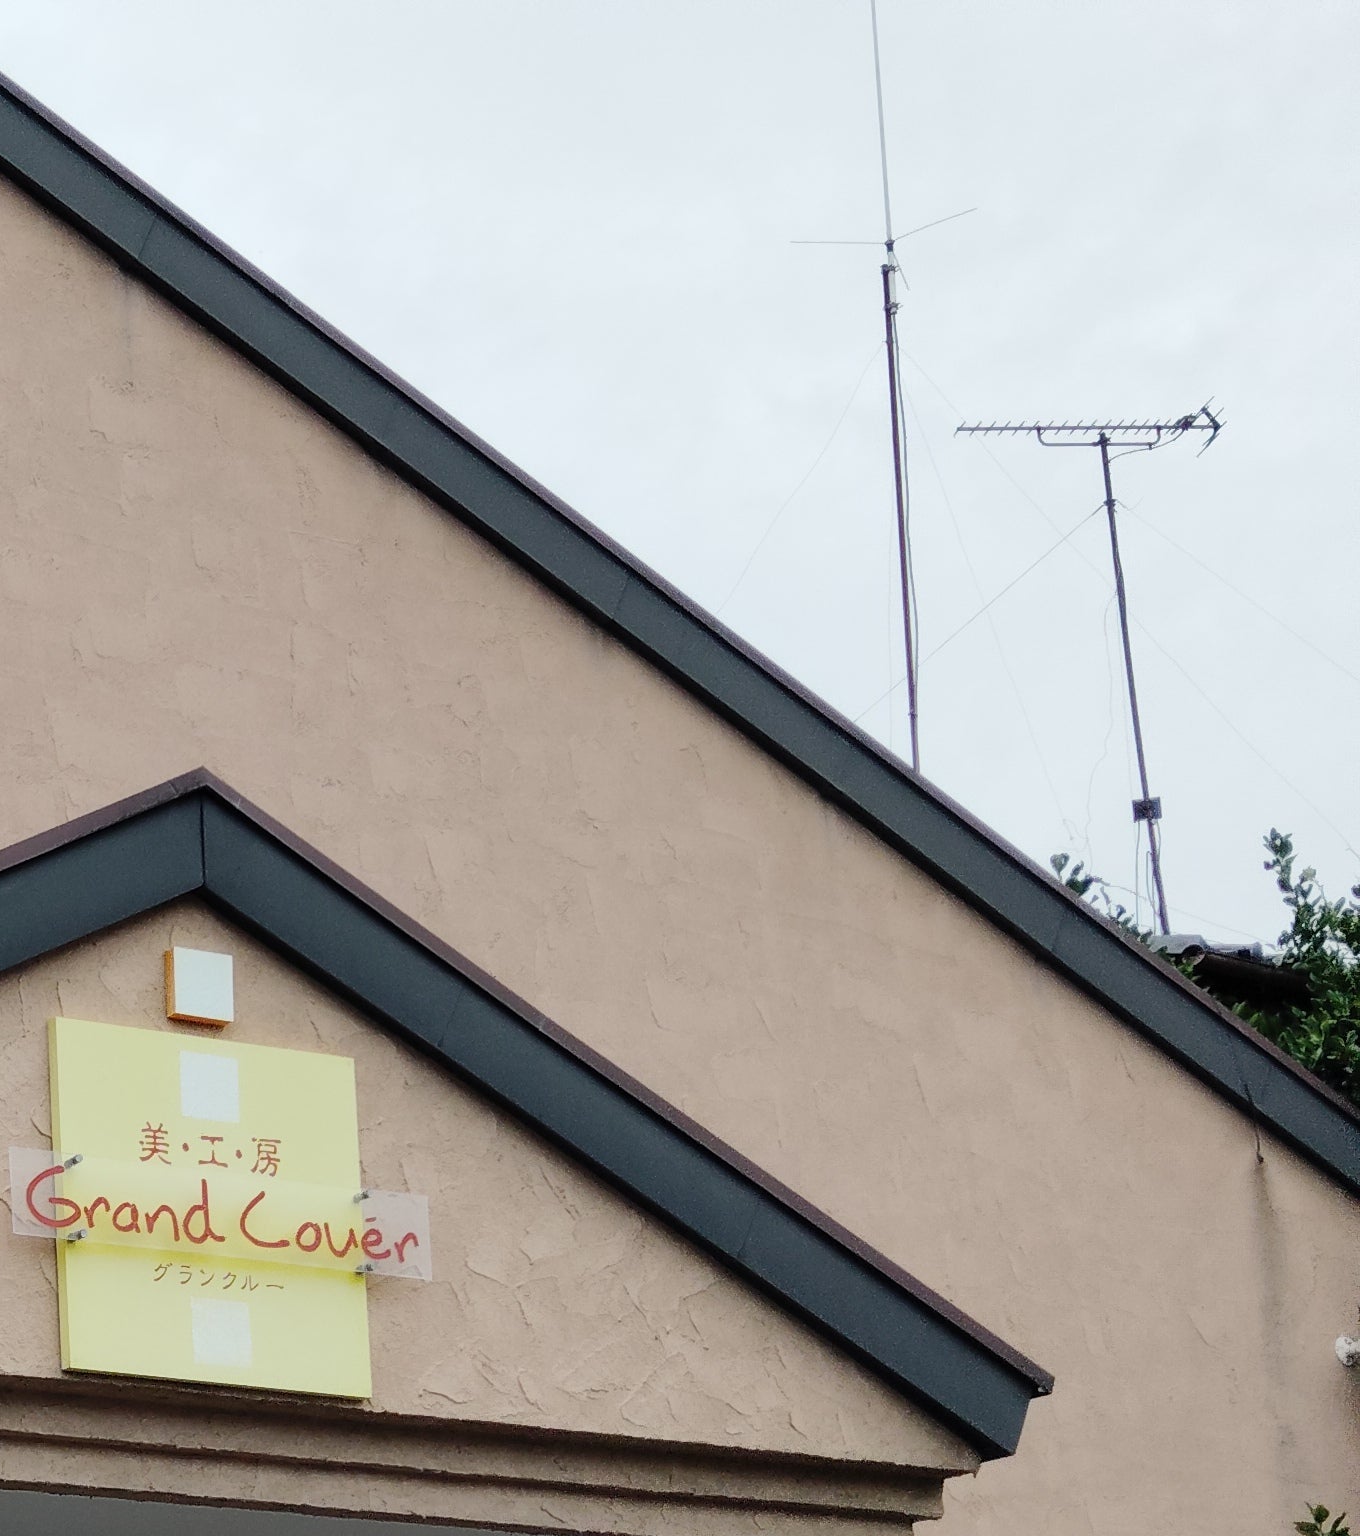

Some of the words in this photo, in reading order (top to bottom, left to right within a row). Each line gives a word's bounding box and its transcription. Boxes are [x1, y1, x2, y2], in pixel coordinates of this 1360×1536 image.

[25, 1164, 225, 1245] Grand
[152, 1261, 285, 1292] グランクルー
